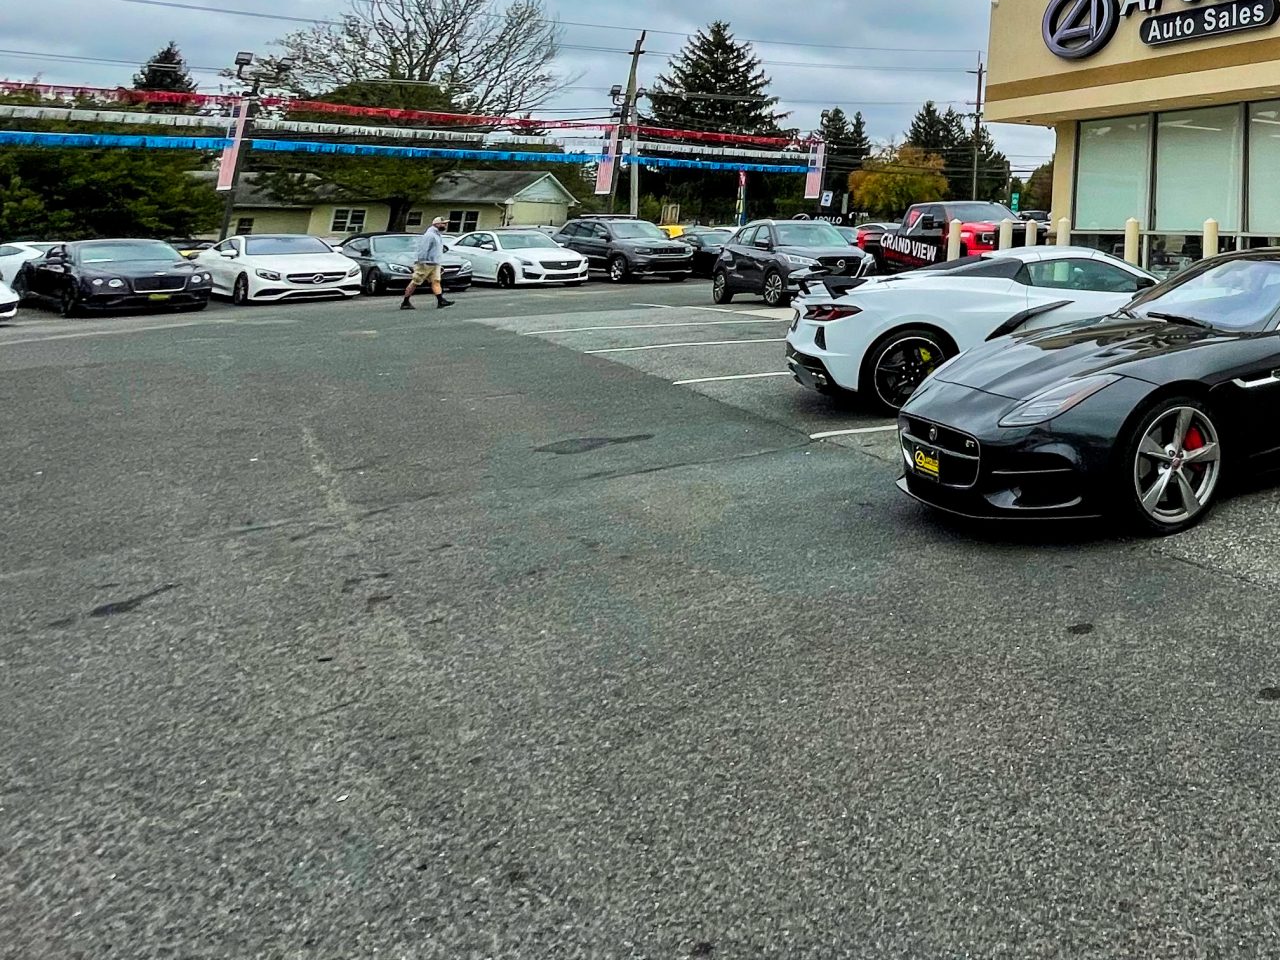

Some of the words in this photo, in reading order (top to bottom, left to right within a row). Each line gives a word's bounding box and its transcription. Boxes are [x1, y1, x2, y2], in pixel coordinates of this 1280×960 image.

[1147, 18, 1195, 41] Auto
[1203, 2, 1265, 32] Sales
[880, 233, 911, 255] GRAND
[911, 240, 937, 262] VIEW
